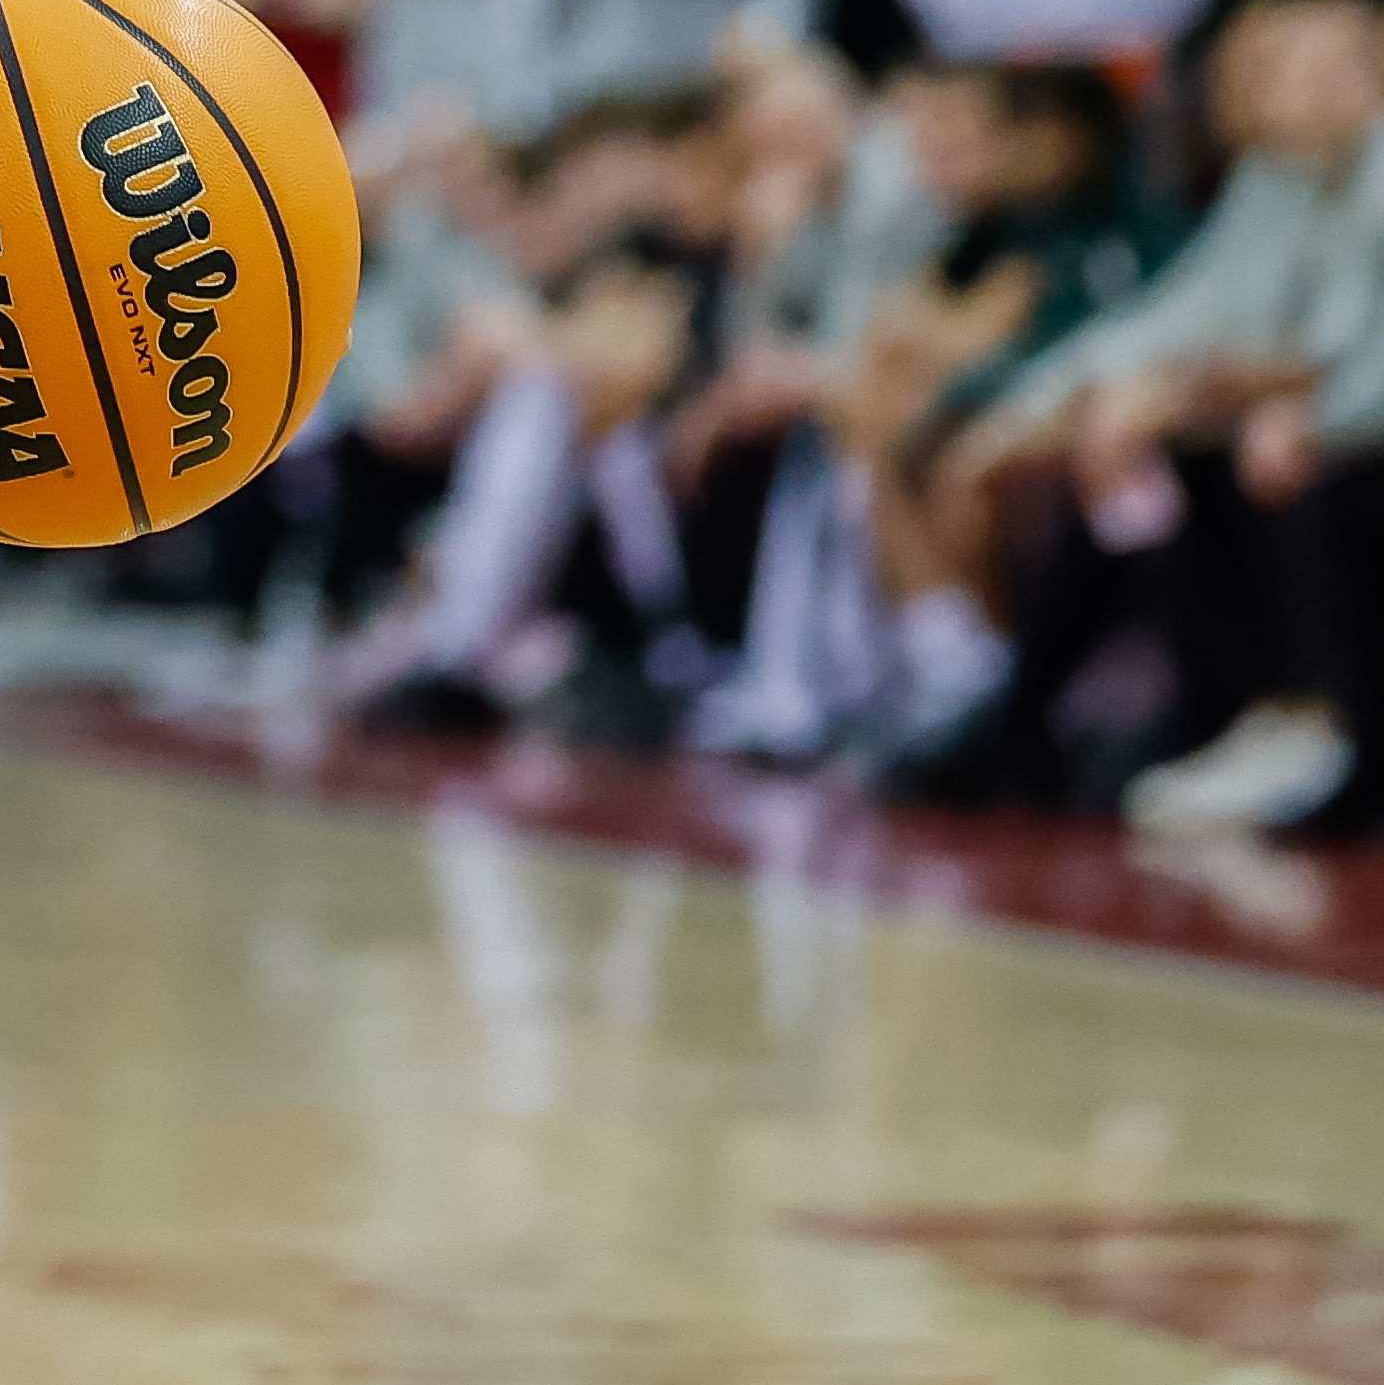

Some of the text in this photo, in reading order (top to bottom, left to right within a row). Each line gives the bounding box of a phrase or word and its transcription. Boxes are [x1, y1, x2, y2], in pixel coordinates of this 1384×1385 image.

[78, 80, 238, 478] Wilson
[109, 262, 155, 376] EVO NXT
